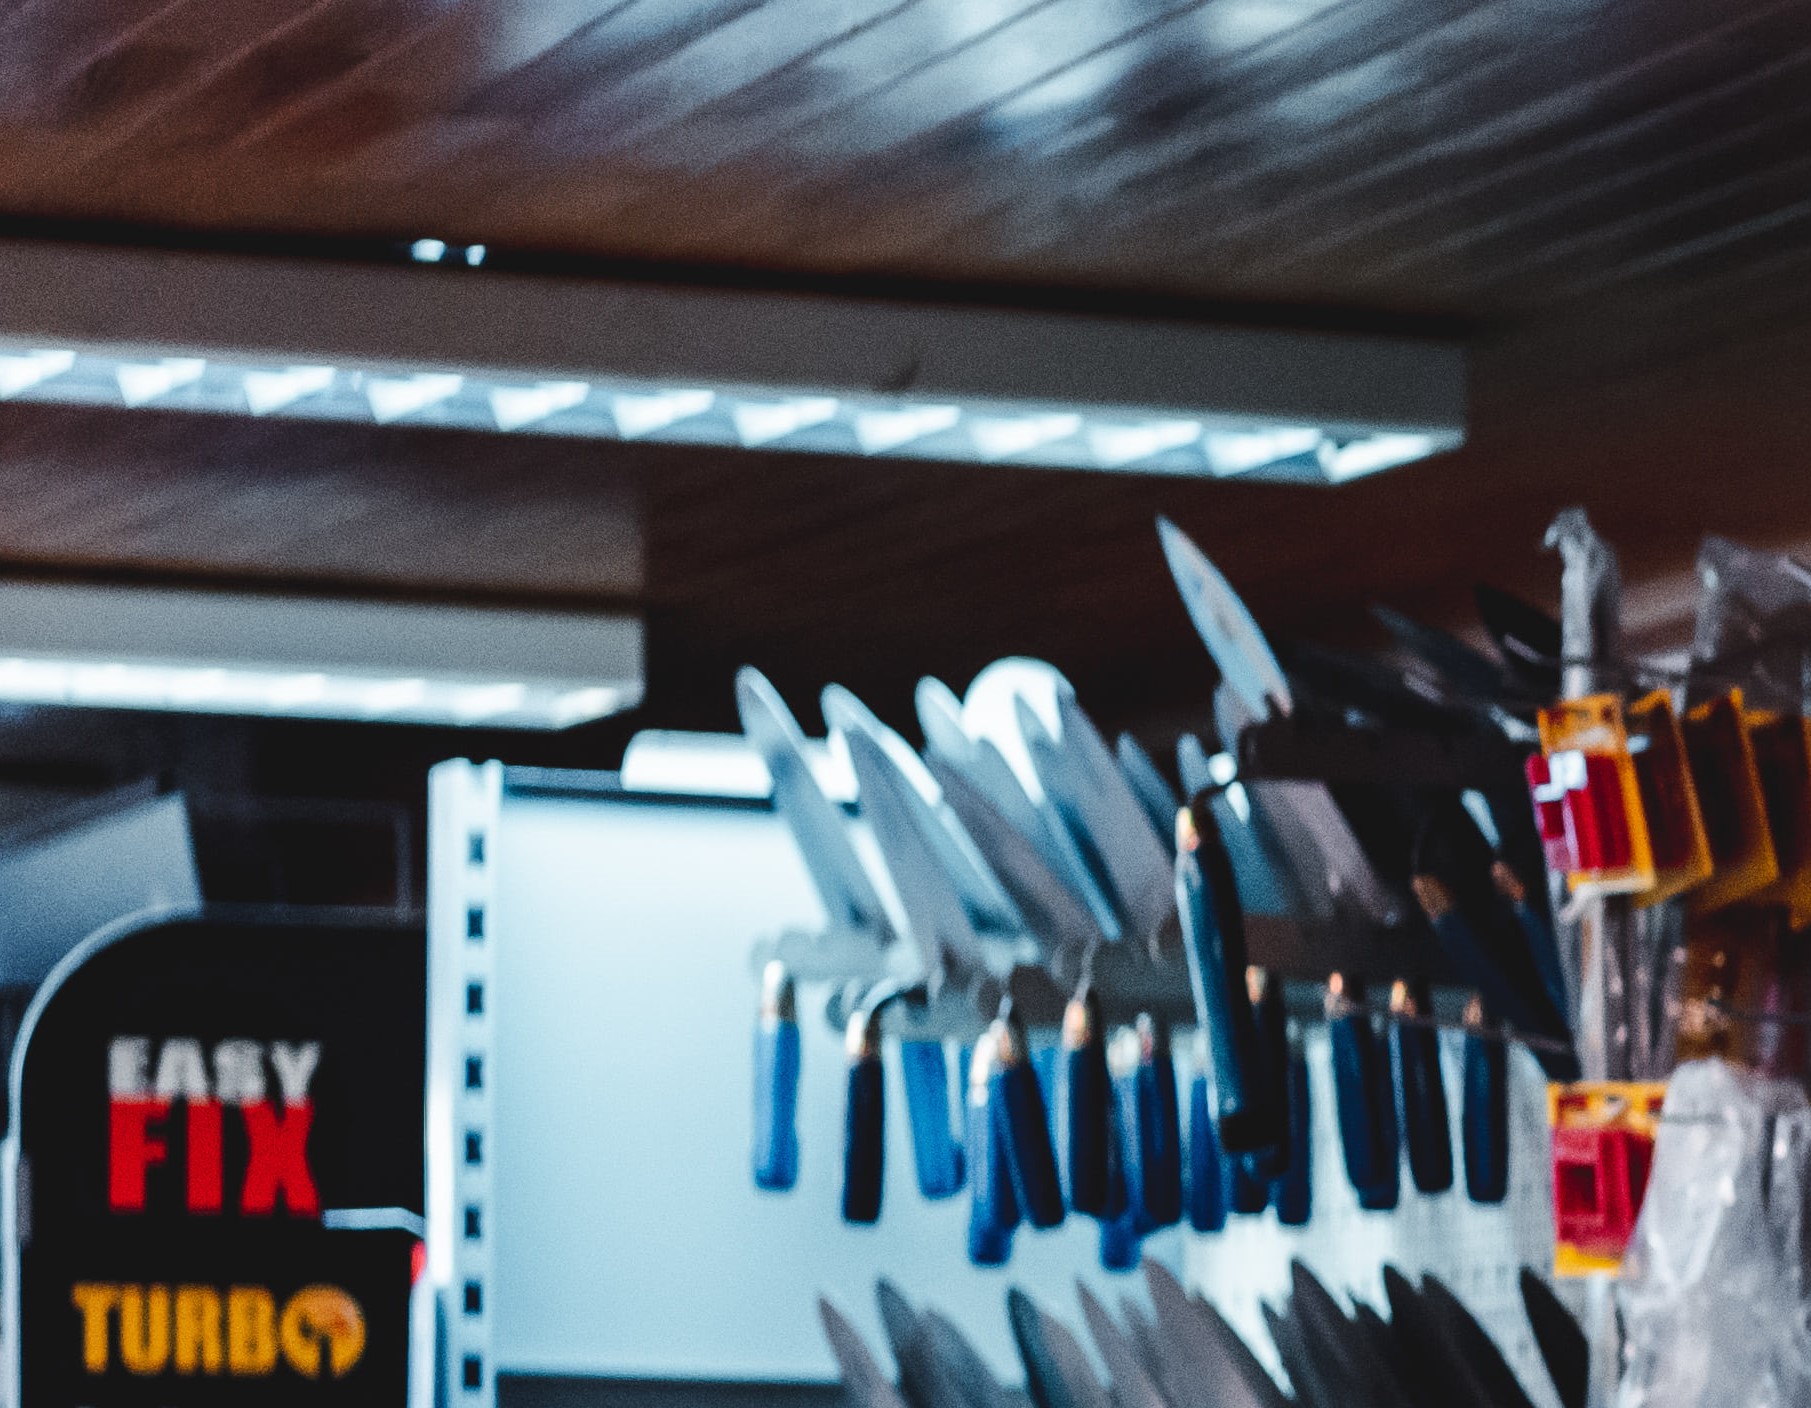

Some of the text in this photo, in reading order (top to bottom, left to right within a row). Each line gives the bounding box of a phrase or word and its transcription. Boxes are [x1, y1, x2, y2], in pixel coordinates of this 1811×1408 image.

[108, 1036, 322, 1106] EASY
[108, 1099, 321, 1216] FIX
[71, 1282, 367, 1378] TURBO
